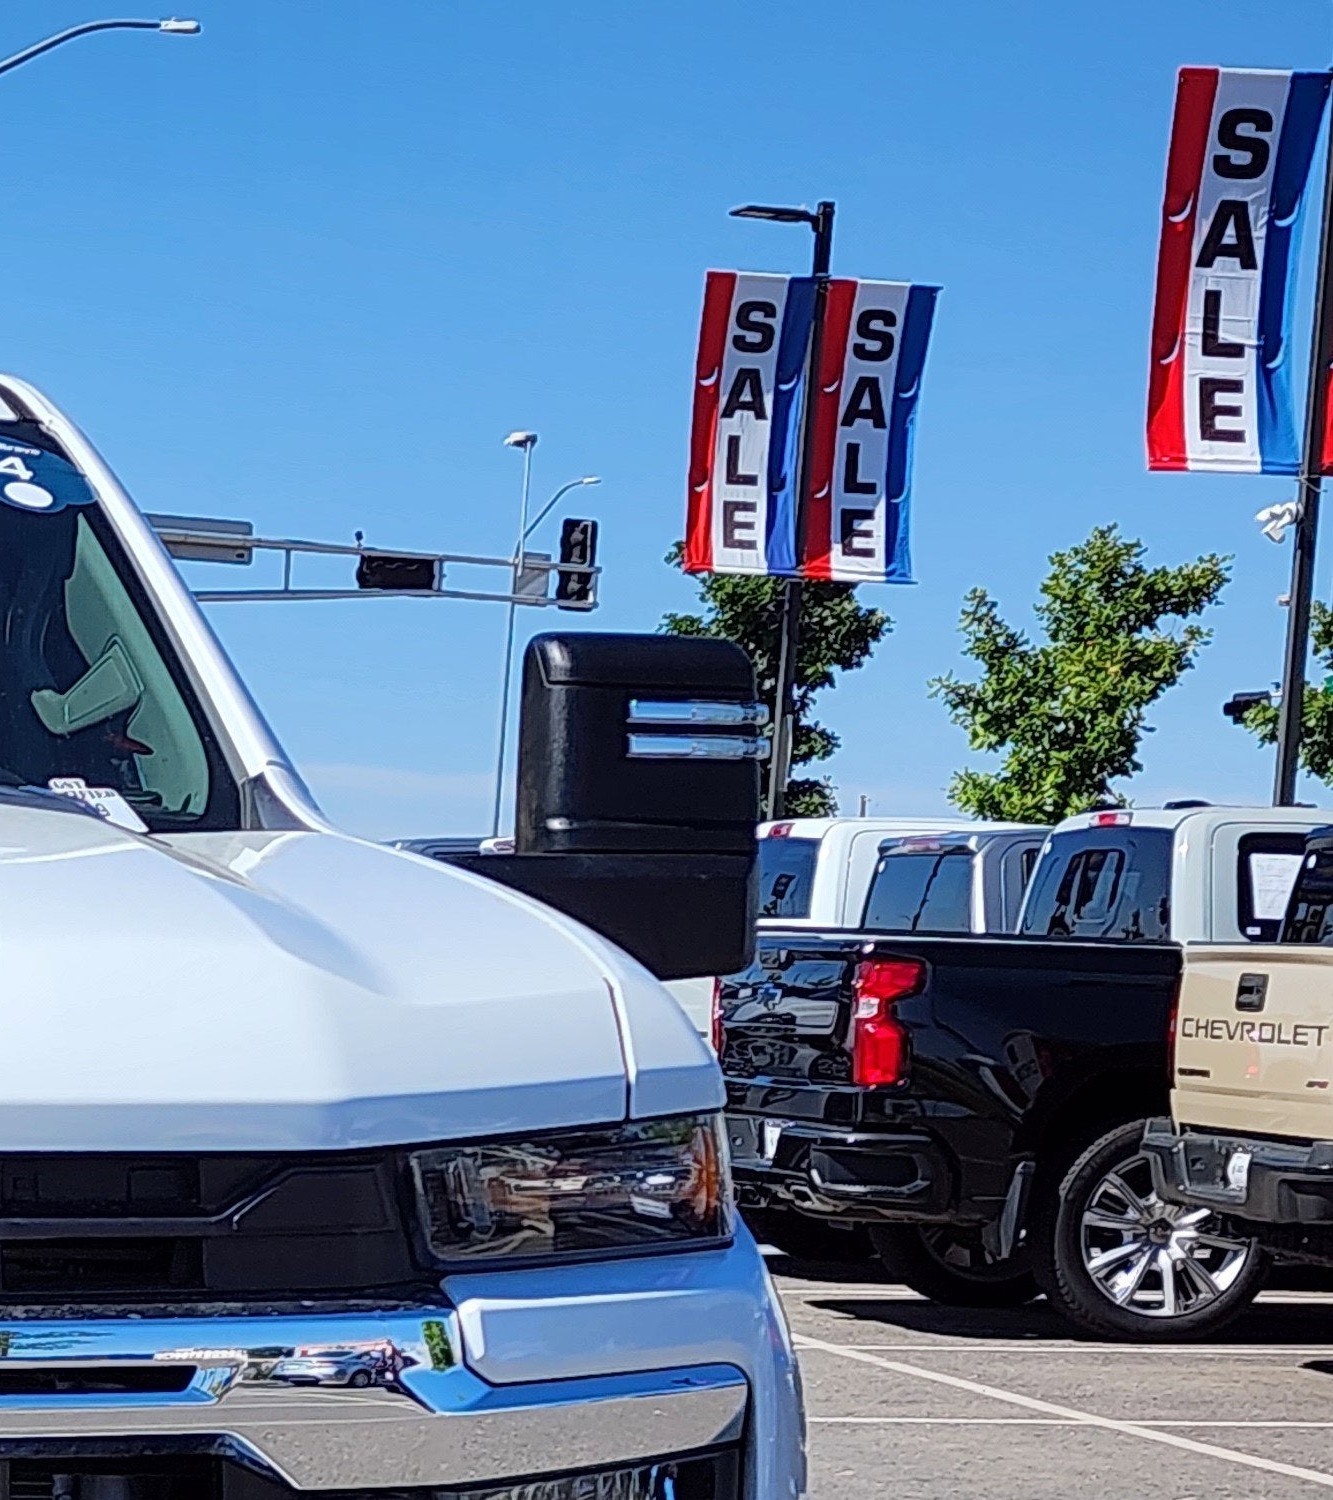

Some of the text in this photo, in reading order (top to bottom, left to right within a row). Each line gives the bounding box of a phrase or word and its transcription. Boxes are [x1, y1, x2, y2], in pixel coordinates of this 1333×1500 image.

[1195, 107, 1274, 445] SALE
[720, 300, 778, 550] SALE
[839, 309, 898, 559] SALE
[1181, 1017, 1330, 1046] CHEVROLET
